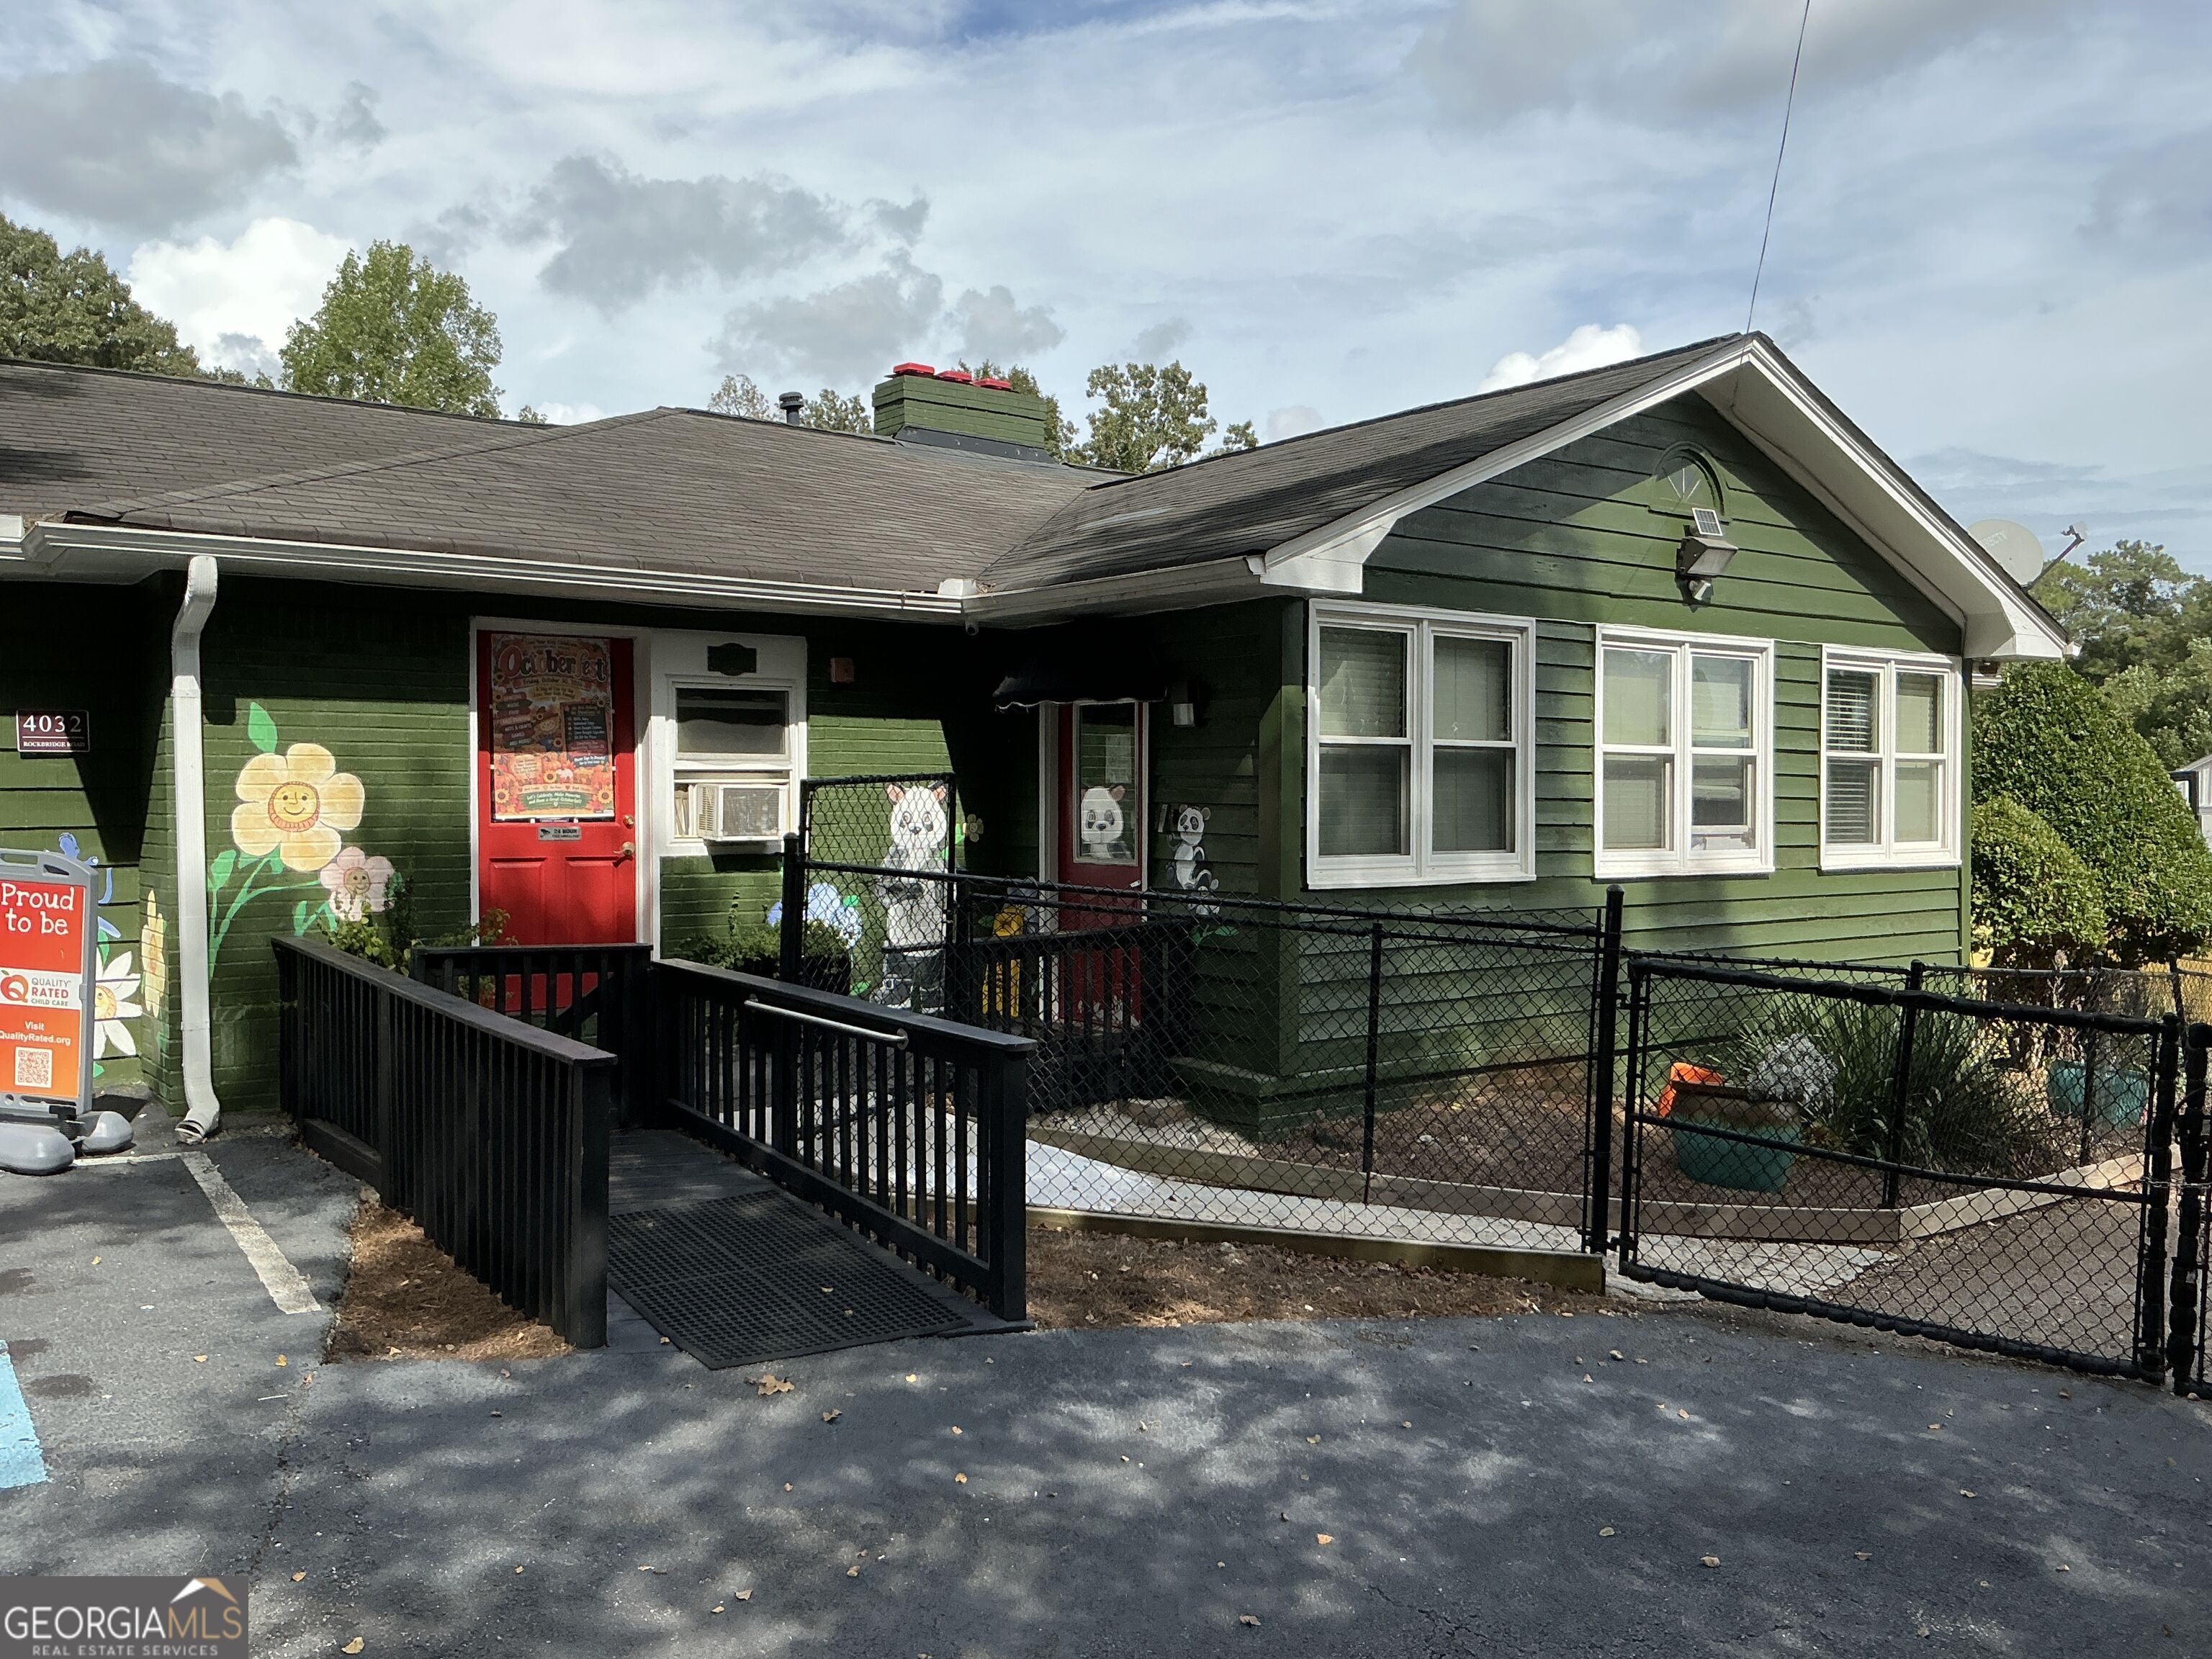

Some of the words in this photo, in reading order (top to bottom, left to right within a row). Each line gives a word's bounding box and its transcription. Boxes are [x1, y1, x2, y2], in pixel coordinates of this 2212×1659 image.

[499, 645, 607, 682] Octoberfest
[23, 715, 81, 732] 4032
[1, 882, 75, 911] Proud
[5, 907, 32, 932] to
[40, 911, 69, 935] be
[31, 977, 69, 988] QUALITY
[31, 987, 69, 999] RATED
[24, 1020, 45, 1031] Visit
[0, 1030, 71, 1046] QualityRated.org
